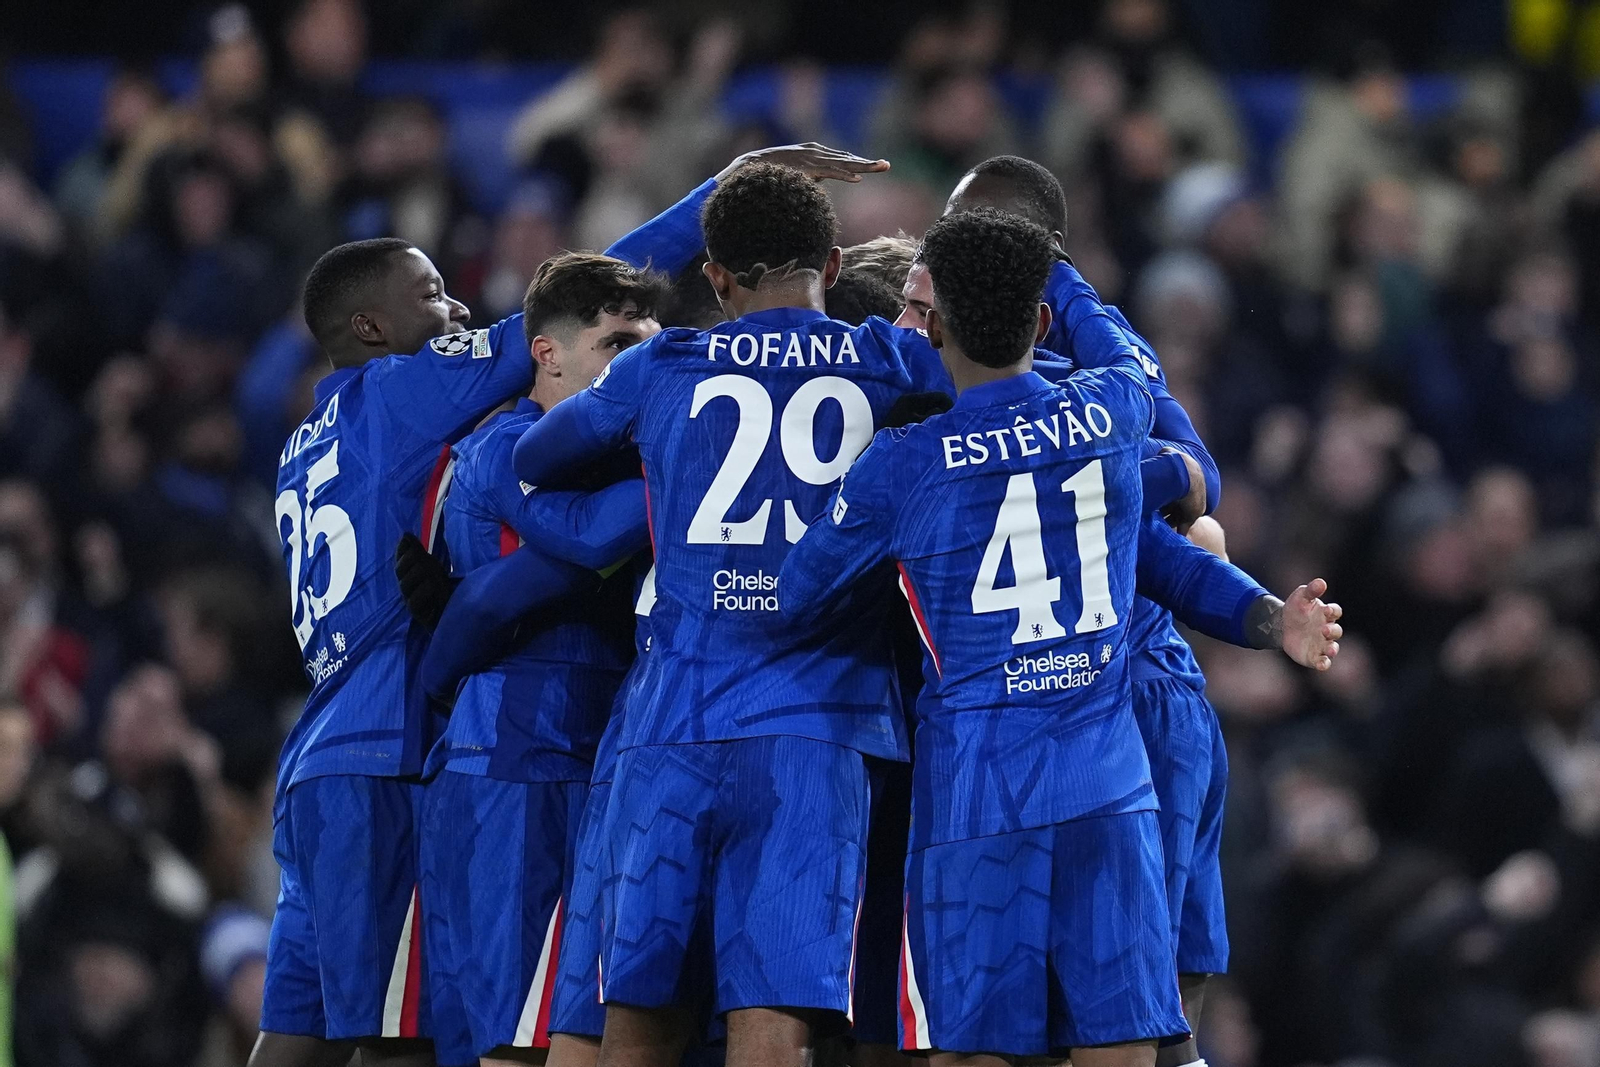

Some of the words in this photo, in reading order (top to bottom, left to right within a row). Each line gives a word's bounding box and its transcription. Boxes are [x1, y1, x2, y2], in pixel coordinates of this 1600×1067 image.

[708, 332, 860, 367] FOFANA
[941, 400, 1112, 469] ESTÊVÃO
[687, 374, 874, 545] 29
[971, 458, 1118, 645] 41
[713, 590, 779, 611] Found
[1004, 650, 1090, 676] Chelsea
[1006, 667, 1102, 695] Foundati
